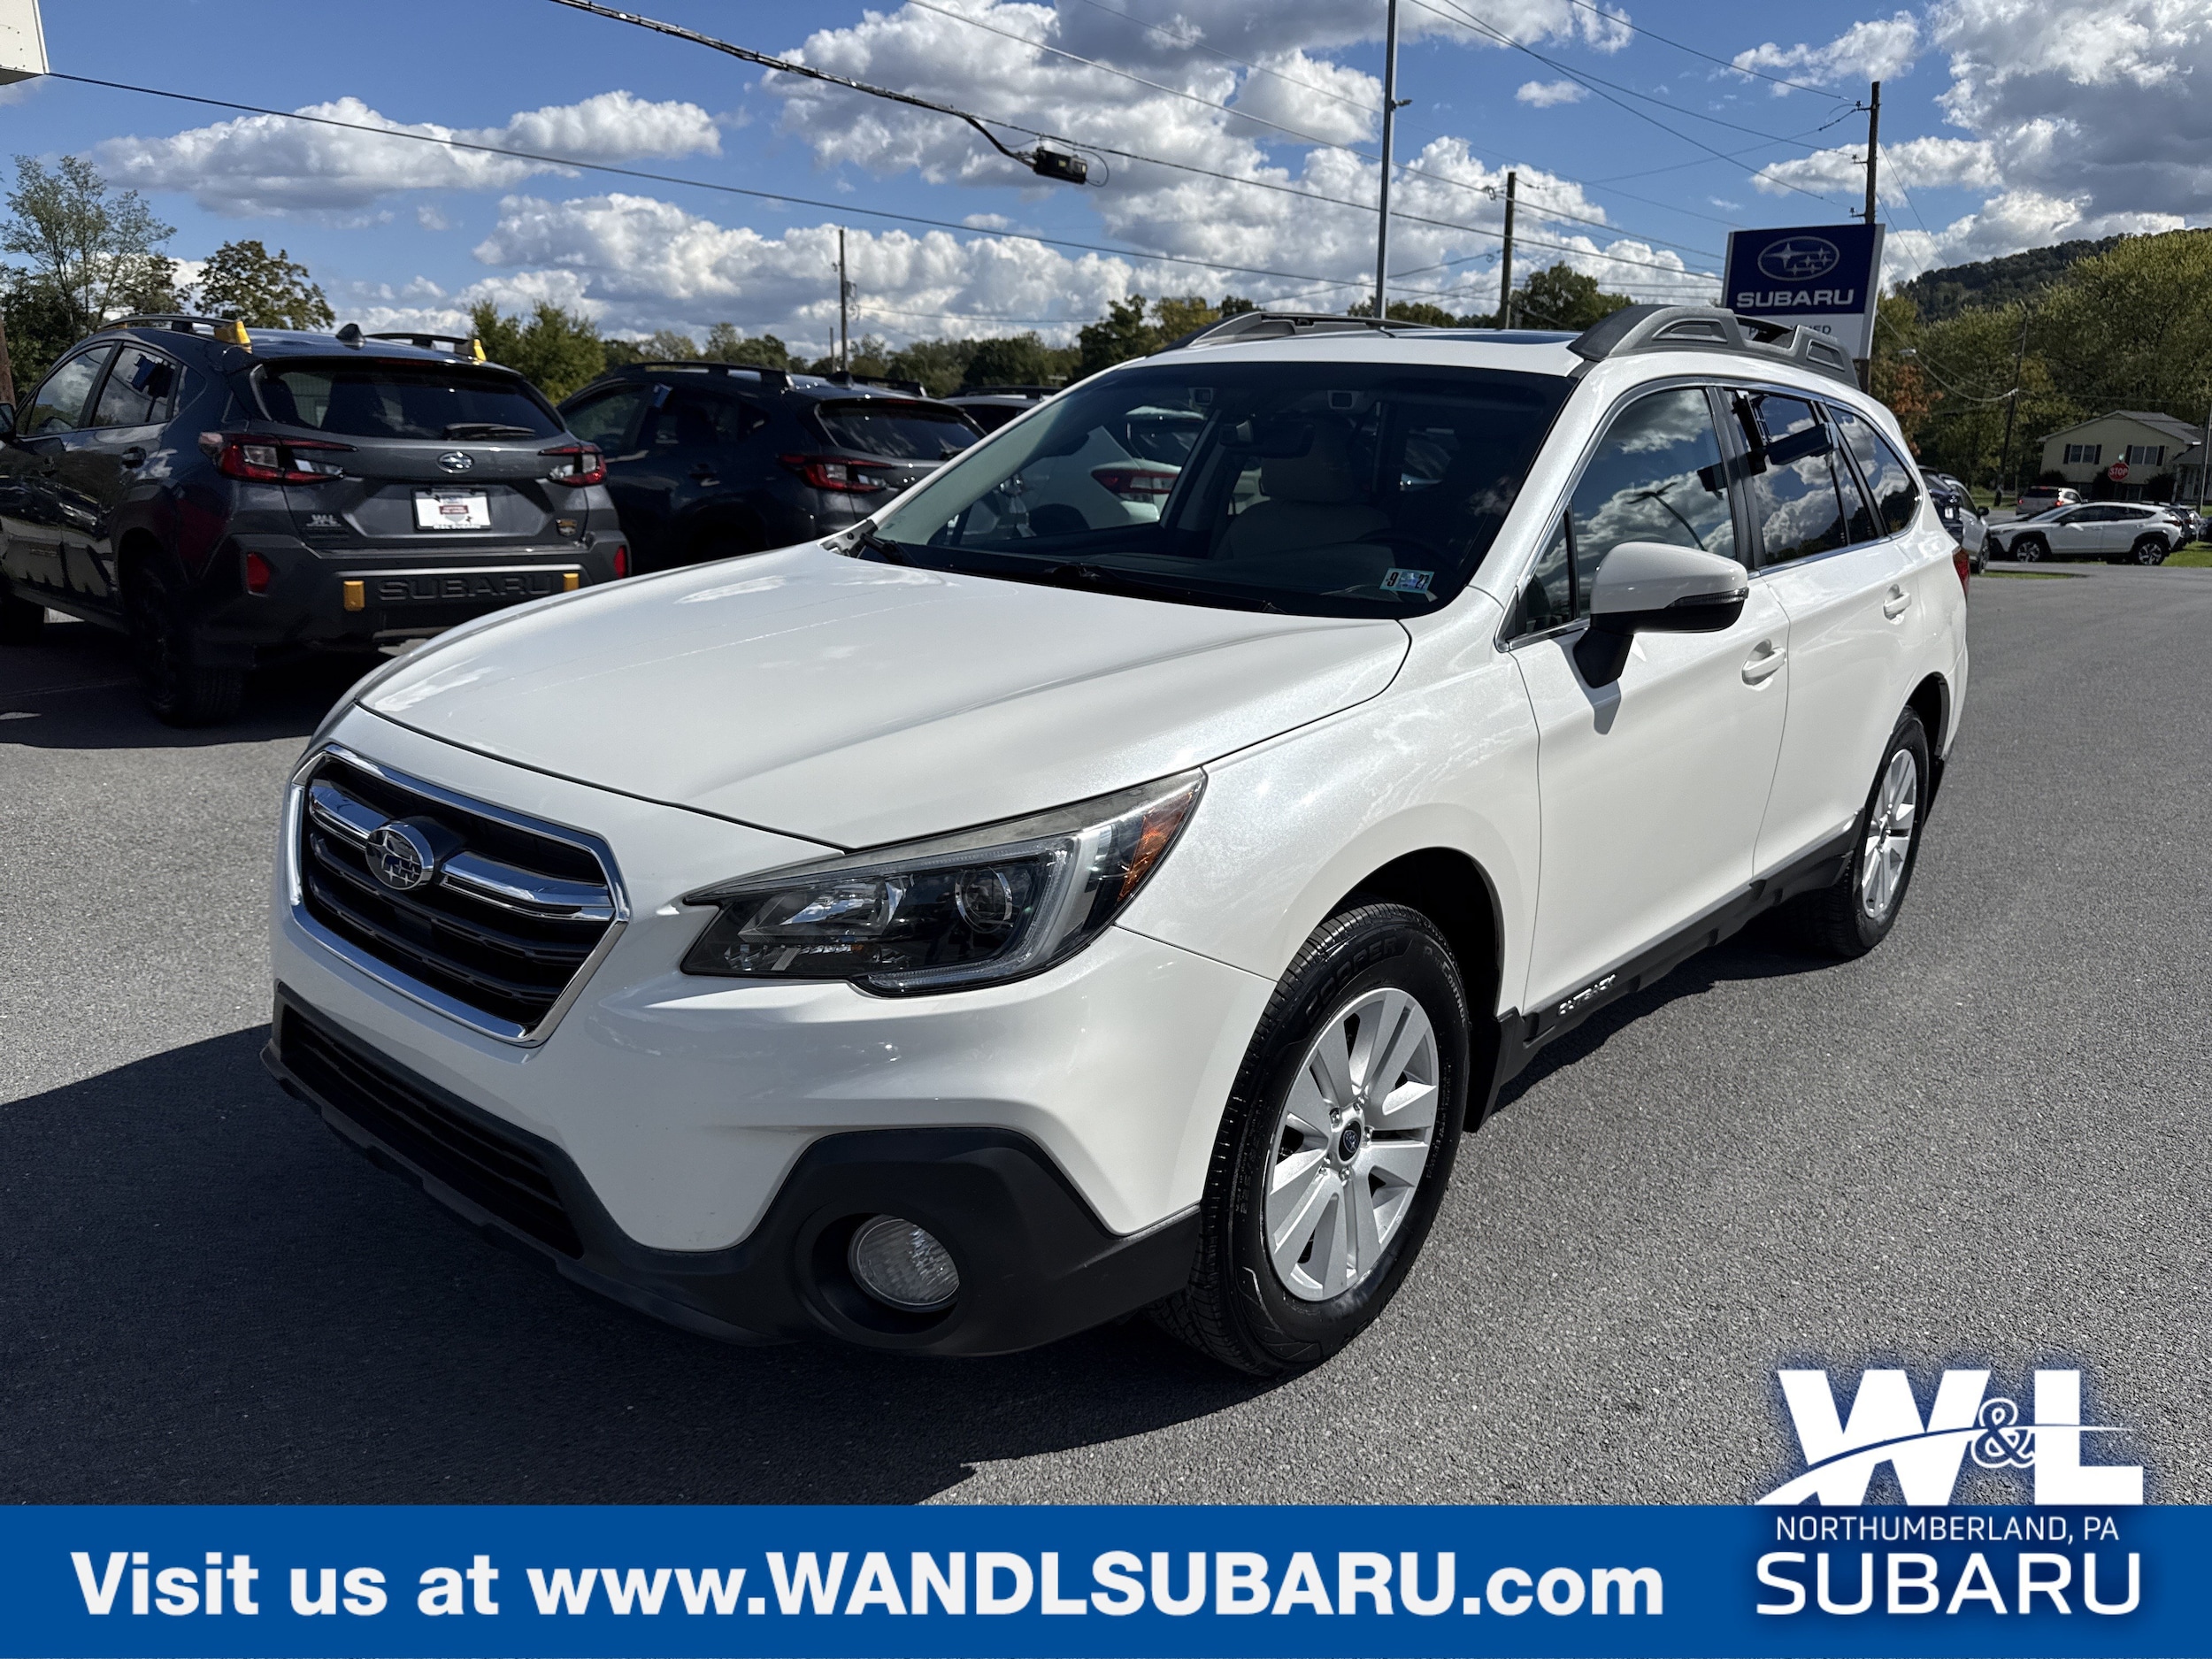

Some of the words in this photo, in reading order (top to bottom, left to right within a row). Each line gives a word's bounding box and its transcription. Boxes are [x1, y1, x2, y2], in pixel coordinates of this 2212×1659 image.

[1736, 289, 1855, 308] SUBARU
[2108, 467, 2128, 476] STOP
[379, 575, 553, 601] SUBARU
[1415, 574, 1430, 589] 27
[1305, 936, 1398, 1025] COOPER
